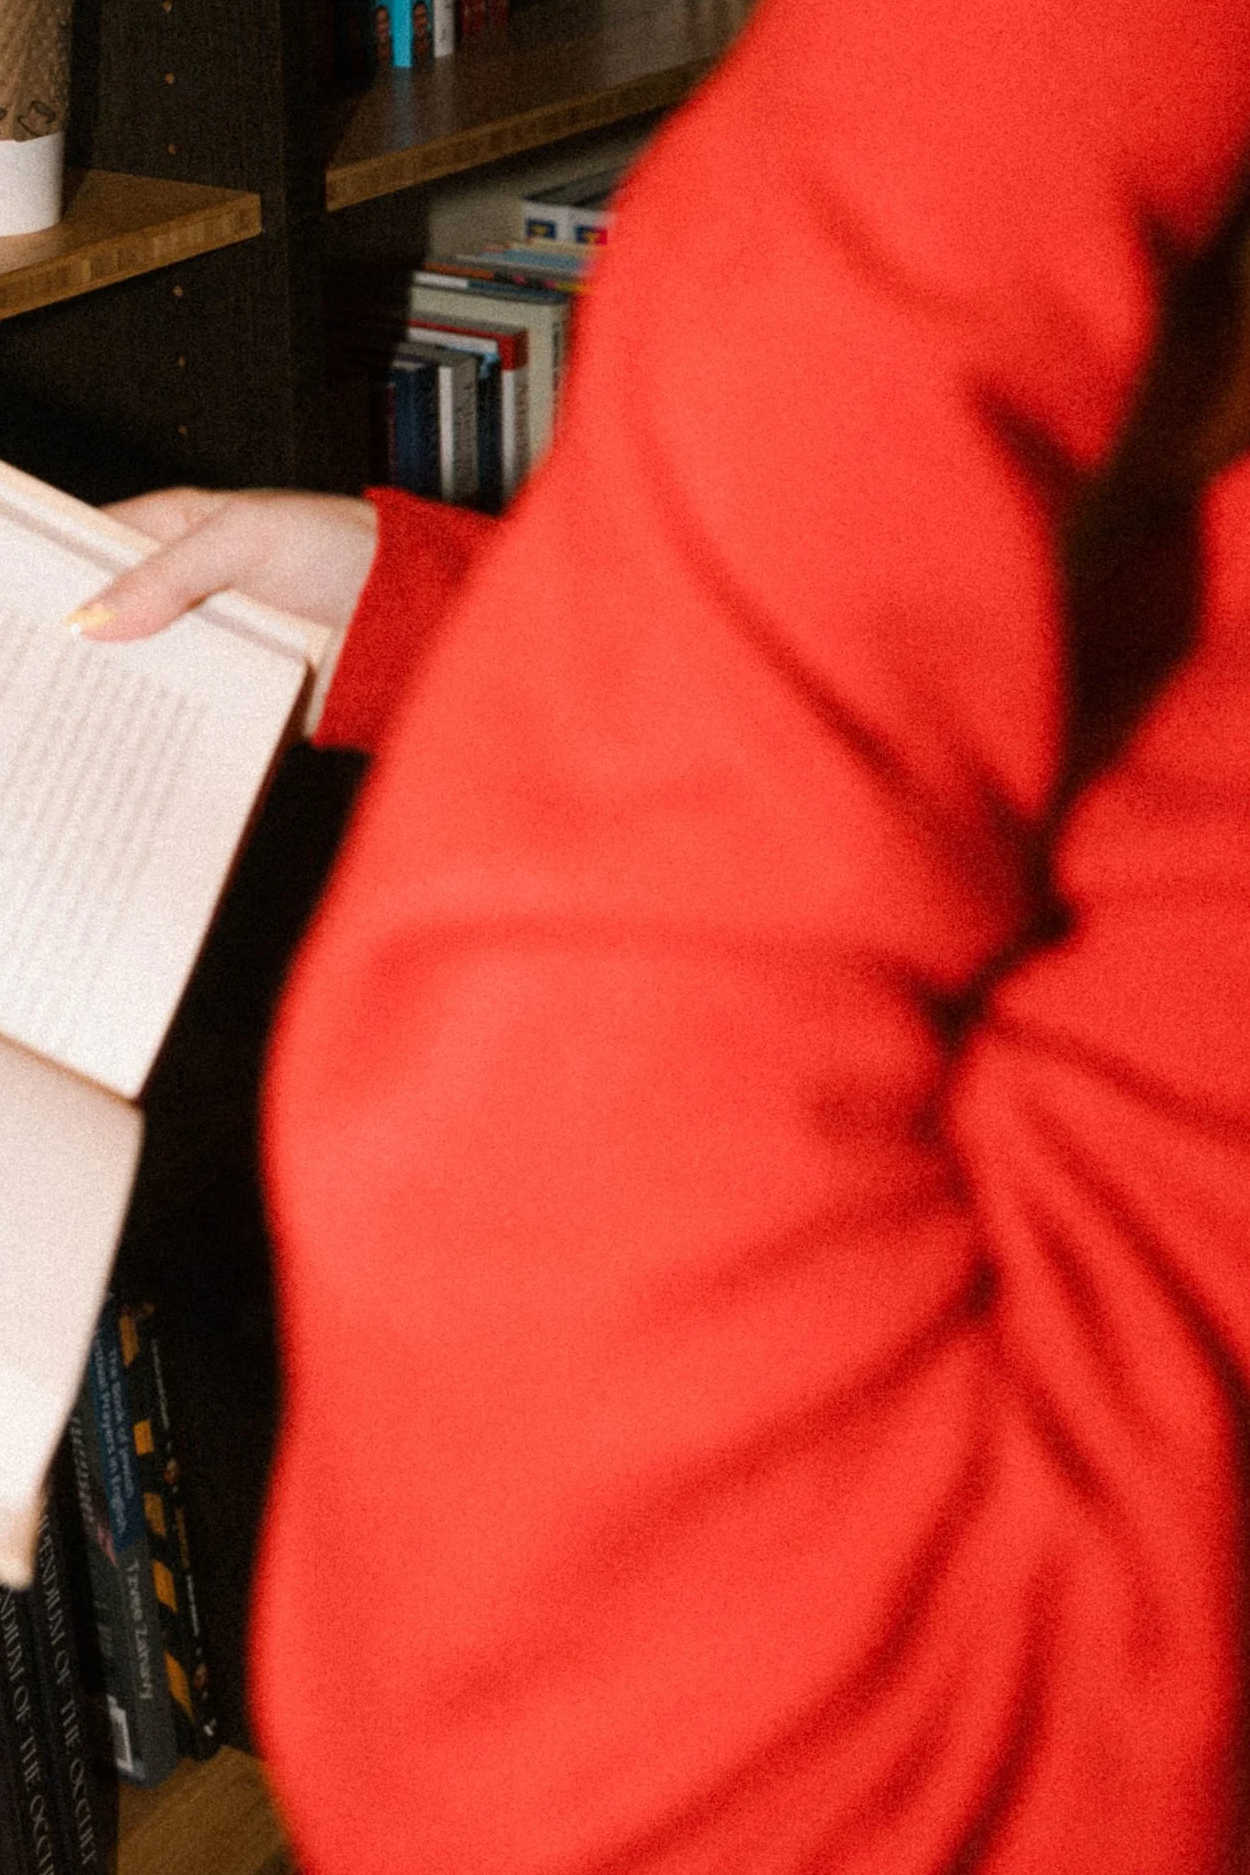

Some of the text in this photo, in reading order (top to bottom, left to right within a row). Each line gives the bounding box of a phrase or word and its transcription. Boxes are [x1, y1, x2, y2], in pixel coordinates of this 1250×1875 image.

[8, 1684, 43, 1780] OF THE
[53, 1650, 97, 1864] OF THE OCCULT
